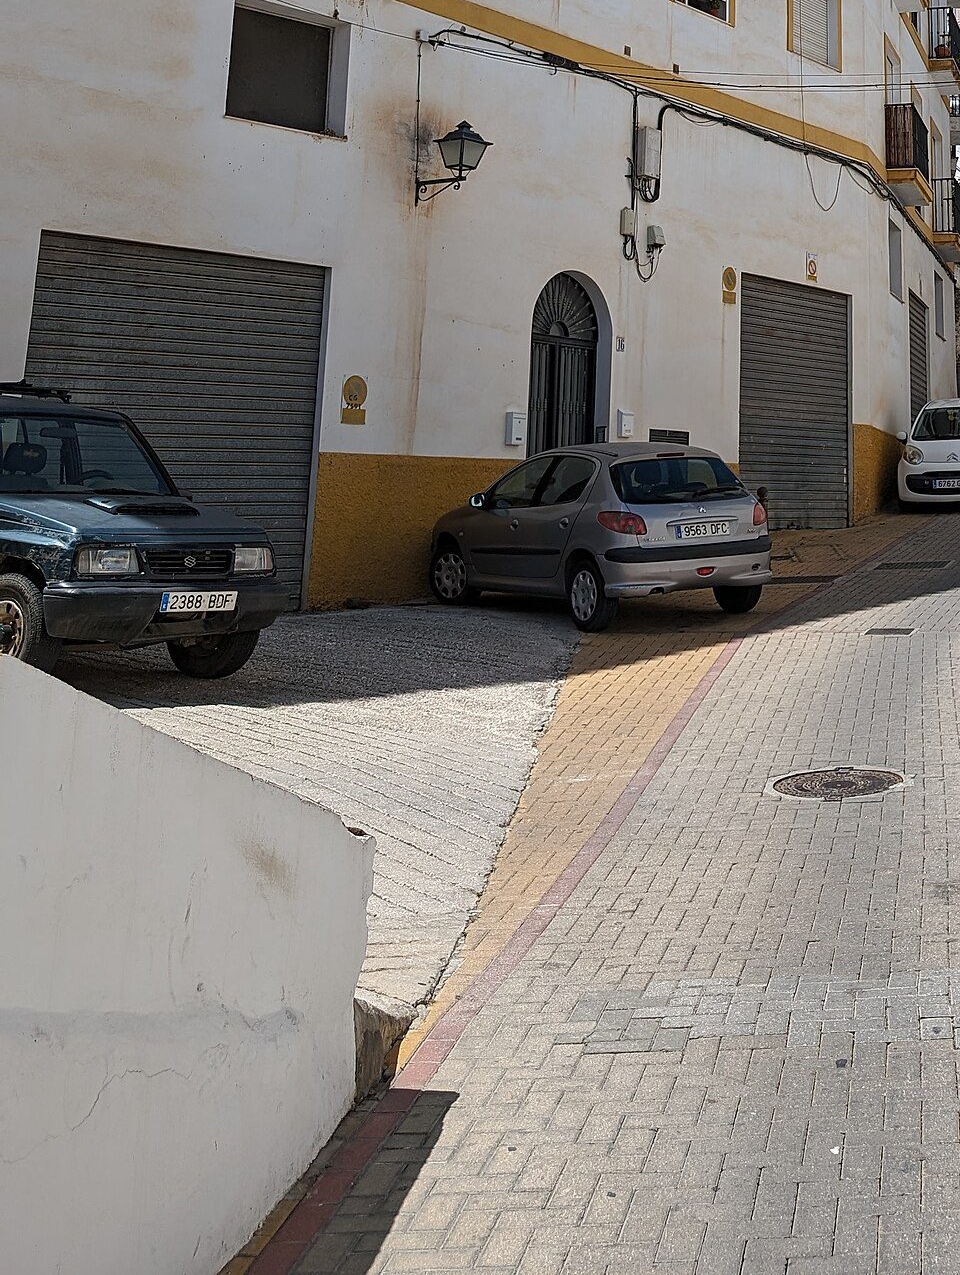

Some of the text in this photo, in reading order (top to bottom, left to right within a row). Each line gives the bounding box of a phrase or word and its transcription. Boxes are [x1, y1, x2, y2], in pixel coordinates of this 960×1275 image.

[684, 522, 728, 537] 9563 DFC
[169, 594, 233, 609] 2388 BDF
